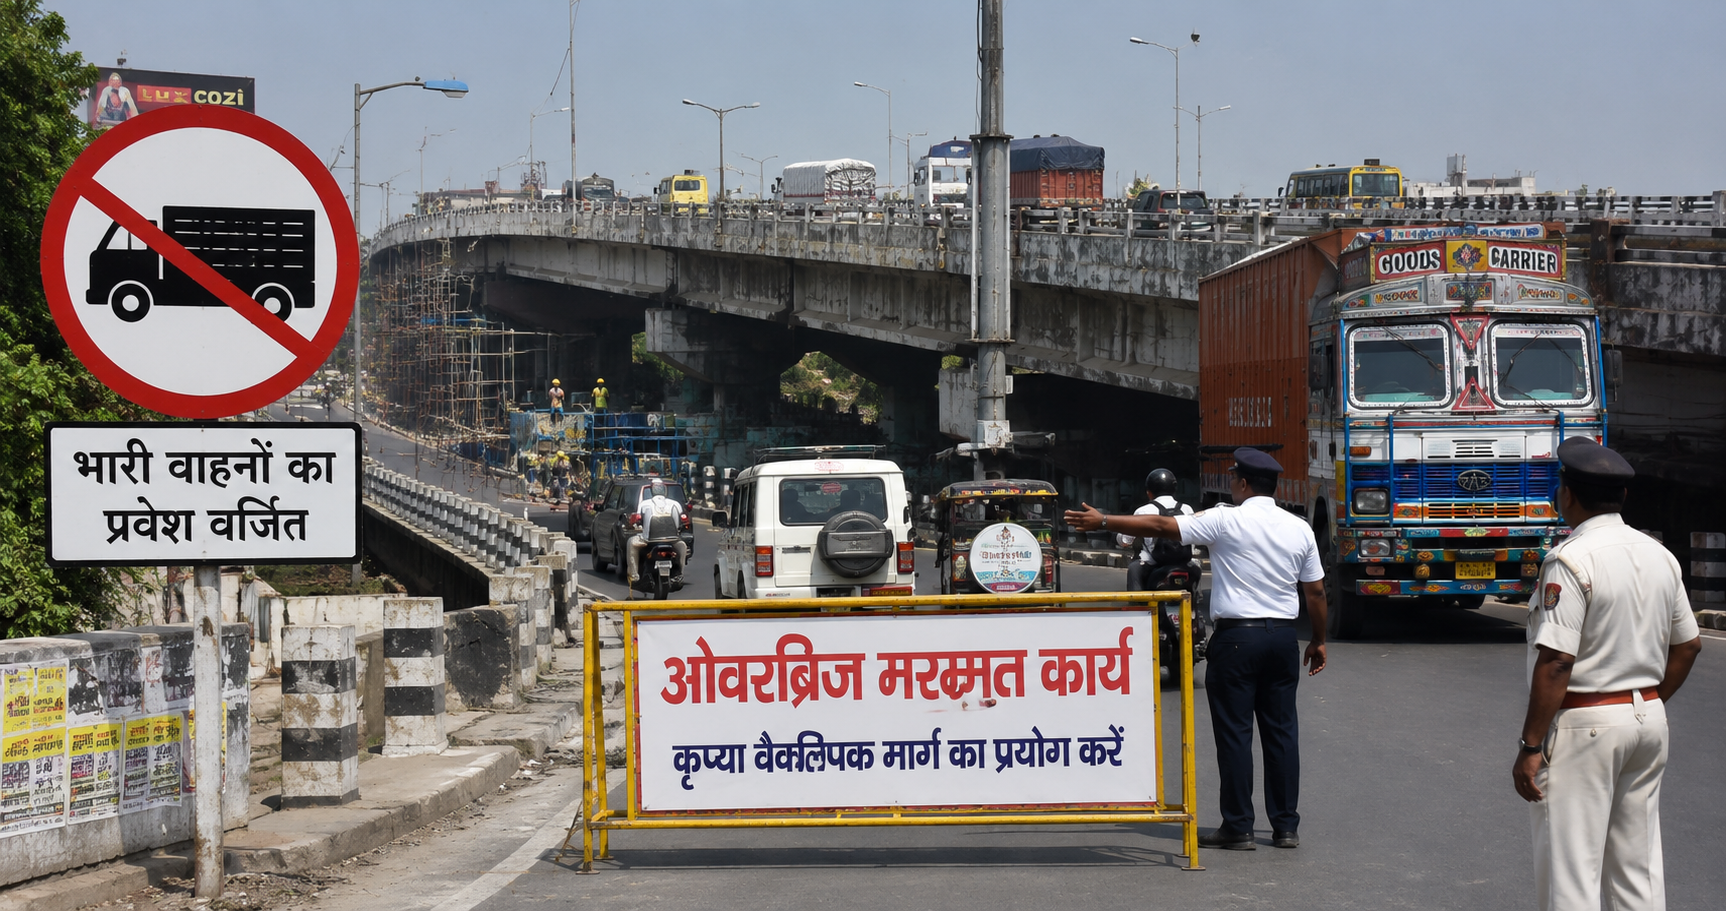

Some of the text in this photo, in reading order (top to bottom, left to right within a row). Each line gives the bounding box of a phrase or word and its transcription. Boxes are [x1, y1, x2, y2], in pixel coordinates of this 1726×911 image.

[1379, 249, 1441, 275] GOODS
[1491, 245, 1558, 274] CARRIER
[73, 437, 337, 489] भारी वाहनों का
[102, 495, 310, 545] प्रवेश वर्जित
[660, 626, 1134, 709] ओवरब्रिज मरम्मत कार्य
[671, 743, 747, 791] कृप्या
[881, 727, 942, 771] मार्ग
[947, 739, 987, 770] का
[994, 725, 1072, 774] प्रयोग
[1077, 723, 1125, 768] करें
